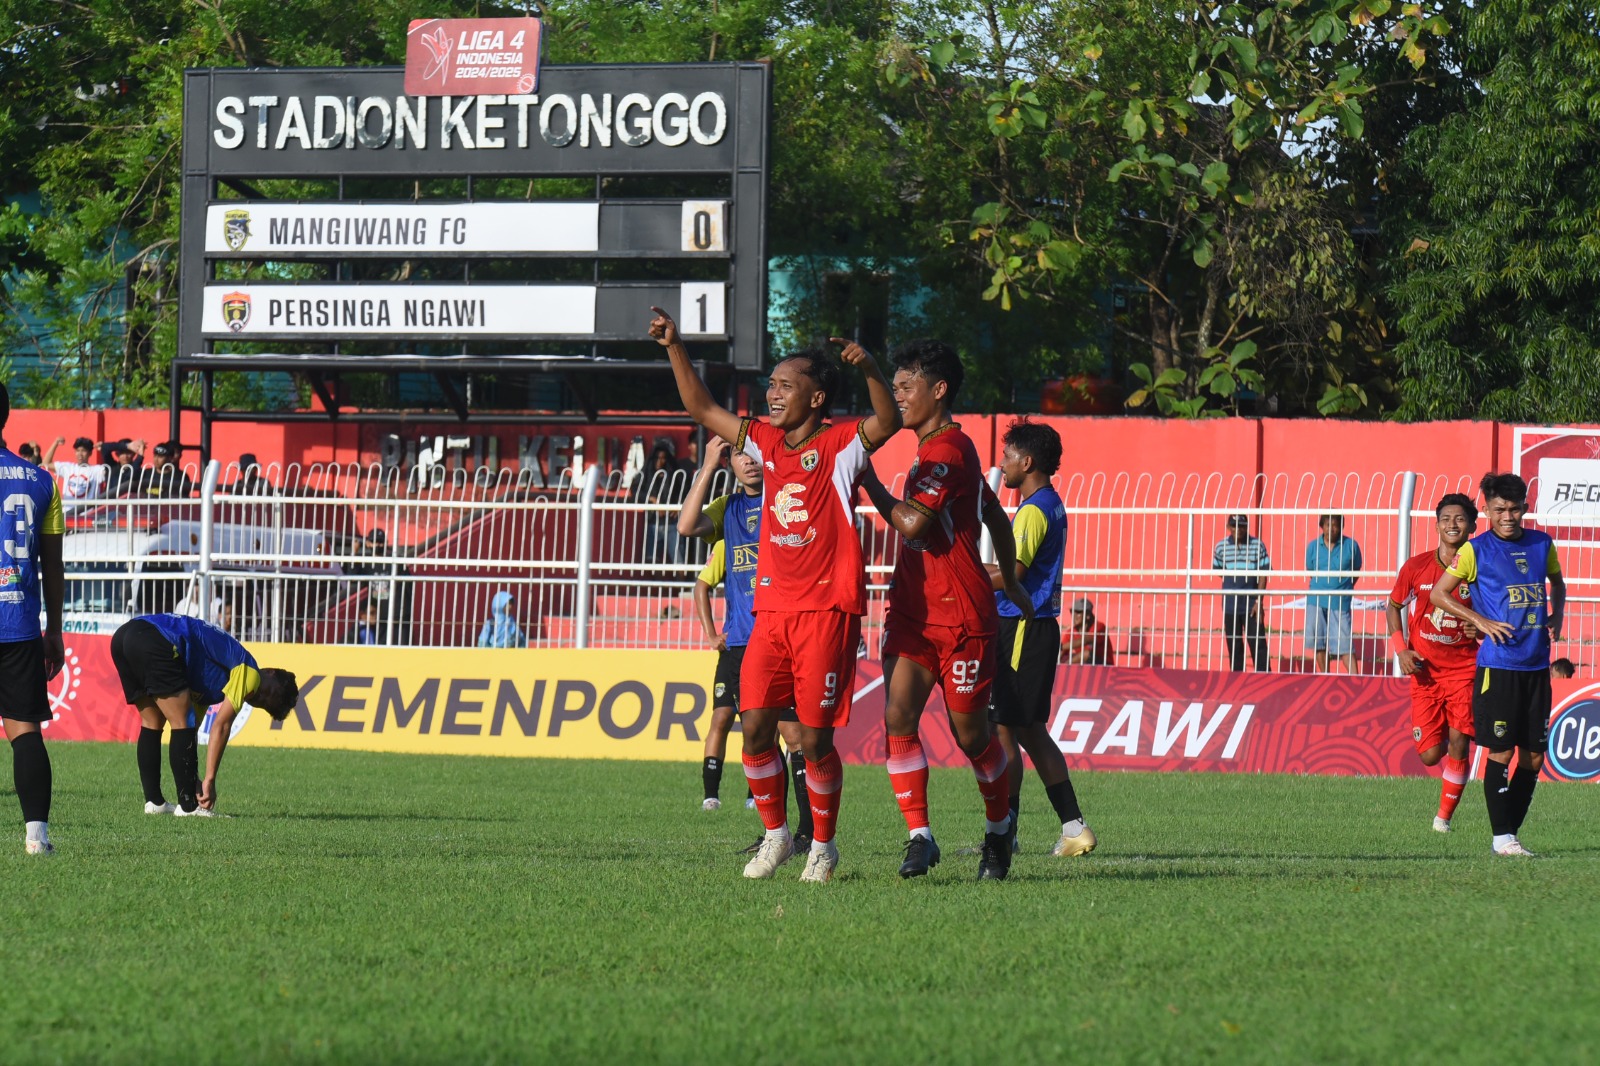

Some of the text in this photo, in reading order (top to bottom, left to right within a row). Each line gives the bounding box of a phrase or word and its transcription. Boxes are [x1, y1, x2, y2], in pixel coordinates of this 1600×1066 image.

[457, 30, 526, 51] LIGA 4
[455, 66, 522, 79] 2024/2025
[456, 52, 523, 65] INDONESIA
[213, 91, 727, 149] STADION KETONGGO
[269, 217, 467, 246] MANGIWANG FC
[693, 210, 712, 251] 0
[269, 299, 486, 327] PERSINGA NGAWI
[695, 294, 708, 333] 1
[824, 672, 837, 698] 9
[951, 659, 980, 685] 93
[269, 676, 738, 742] KEMENPOR
